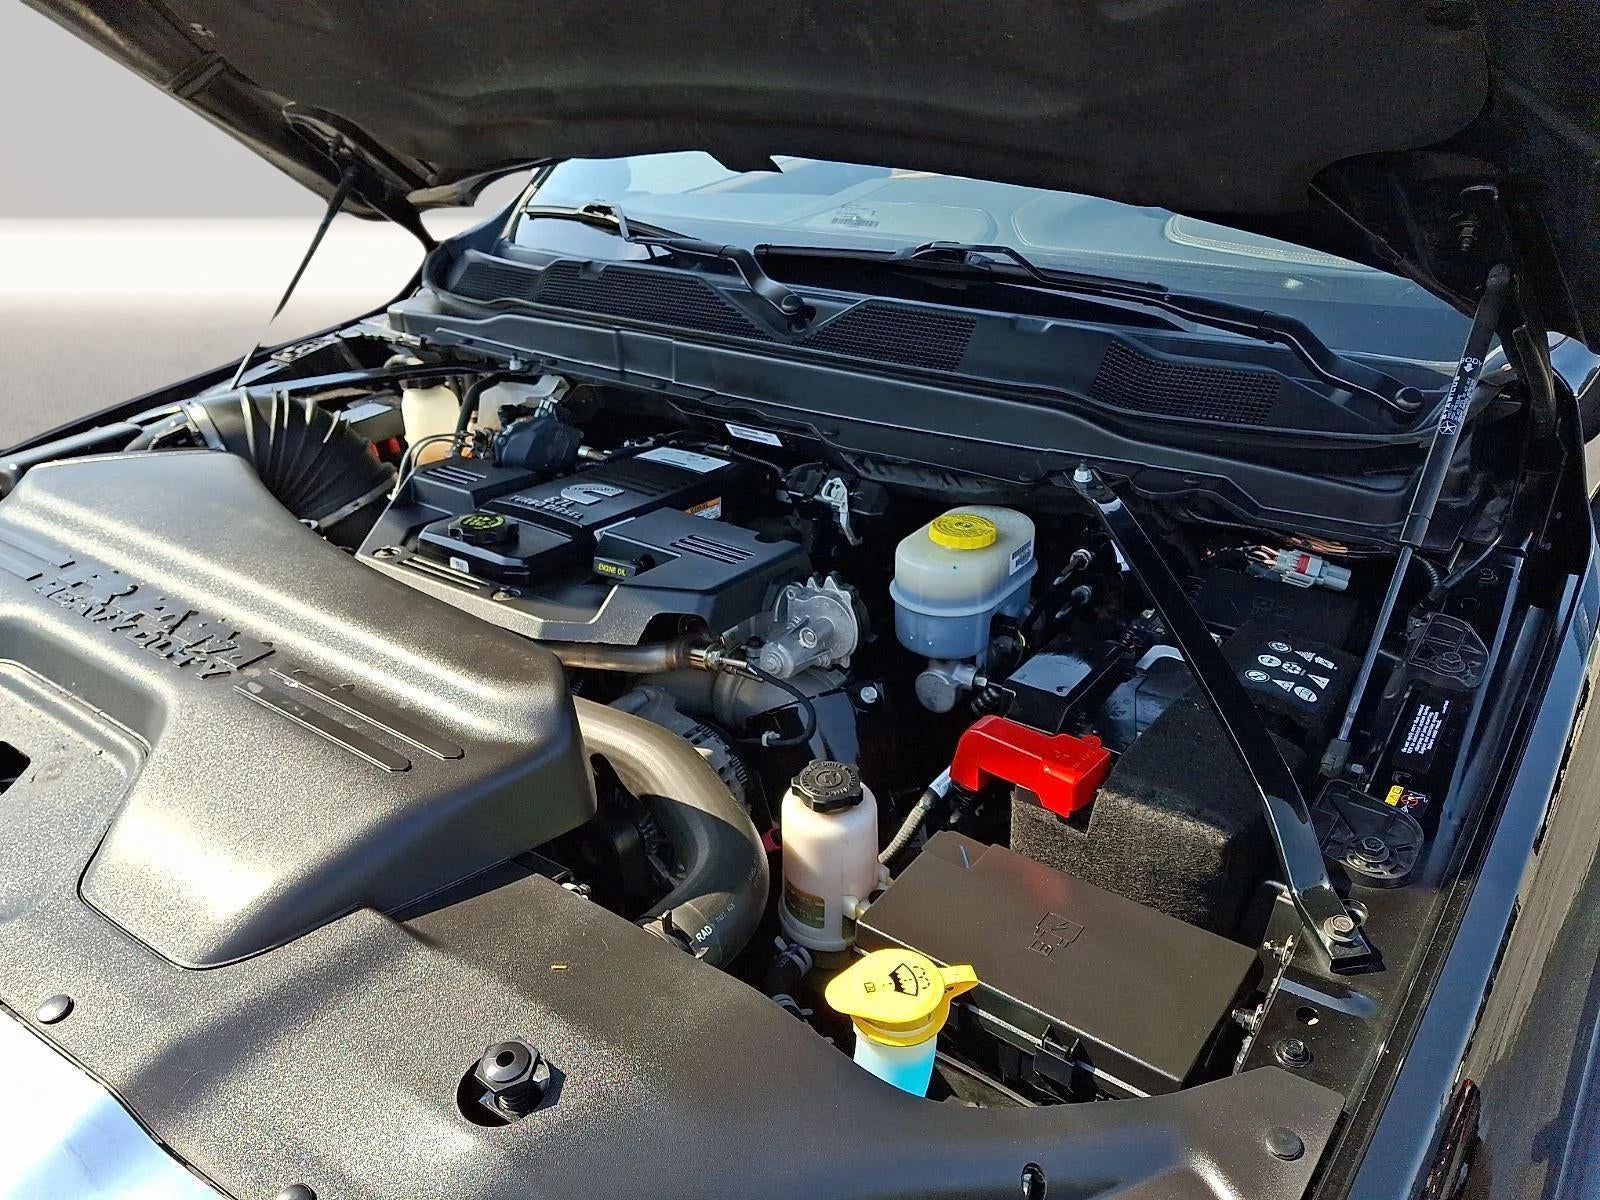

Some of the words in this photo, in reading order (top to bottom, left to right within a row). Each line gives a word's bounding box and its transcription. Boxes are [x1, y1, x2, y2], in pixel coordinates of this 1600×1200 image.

[1460, 356, 1483, 368] BODY
[543, 504, 583, 520] DIESEL
[598, 563, 617, 575] ENGINE
[617, 568, 628, 578] OIL
[695, 925, 713, 943] RAD
